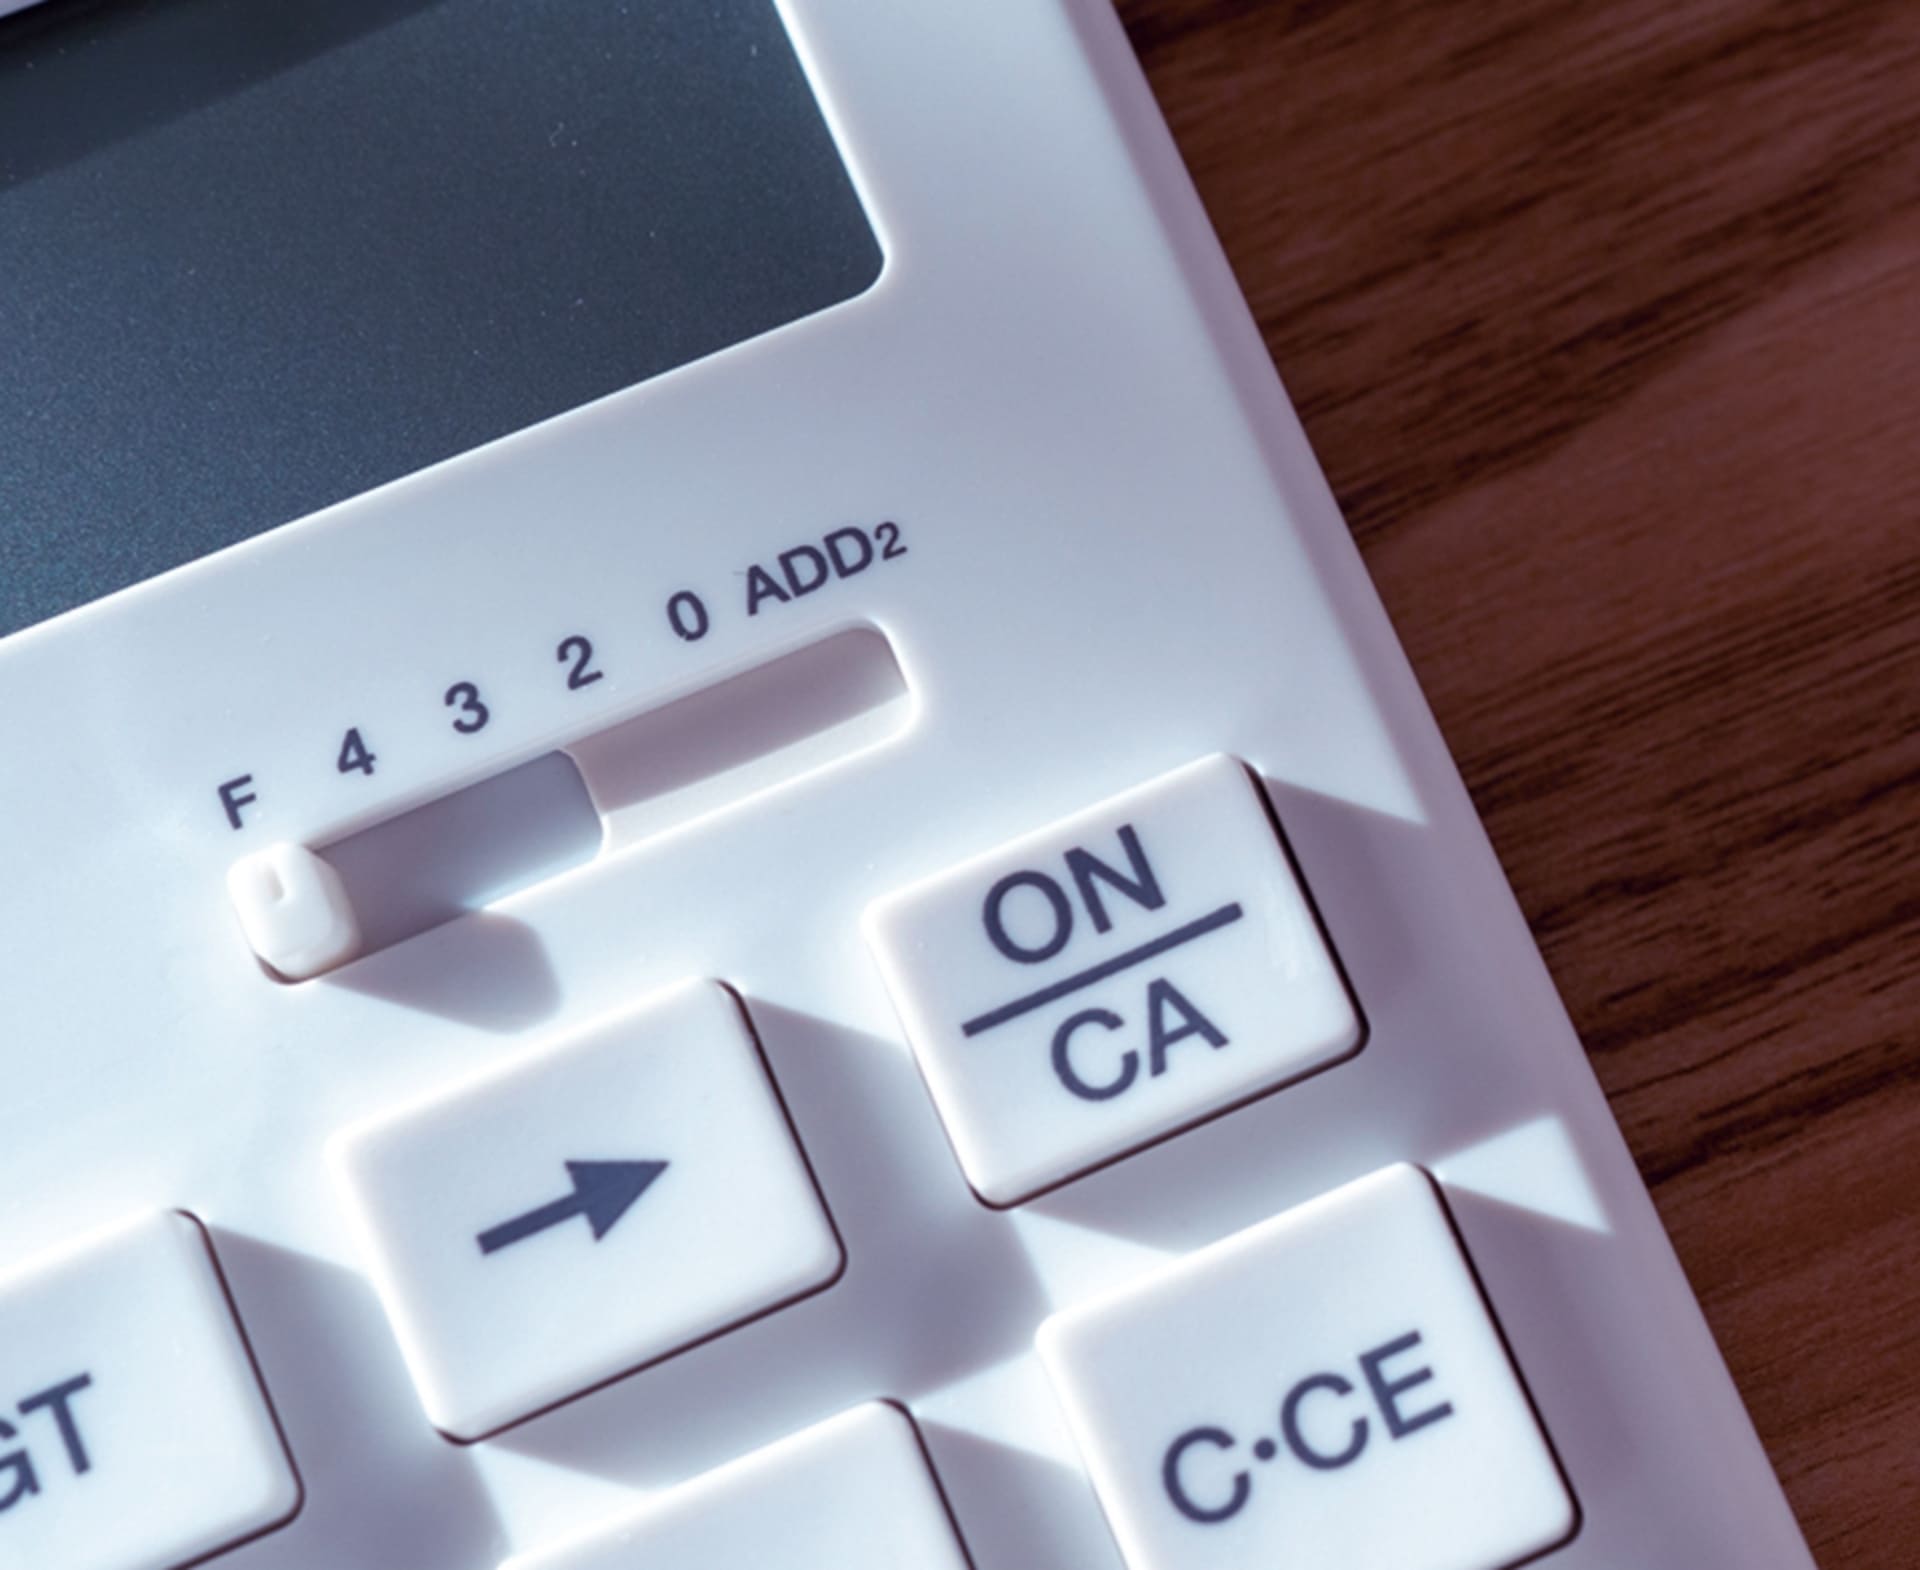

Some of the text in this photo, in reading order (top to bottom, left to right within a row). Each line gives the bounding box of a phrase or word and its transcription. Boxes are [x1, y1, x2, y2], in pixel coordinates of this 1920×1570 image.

[217, 773, 257, 830] F
[337, 727, 377, 776] 4
[444, 681, 490, 735] 3
[556, 635, 604, 691] 2
[666, 590, 710, 642] 0
[981, 823, 1167, 965] ON
[1050, 977, 1230, 1102] CA
